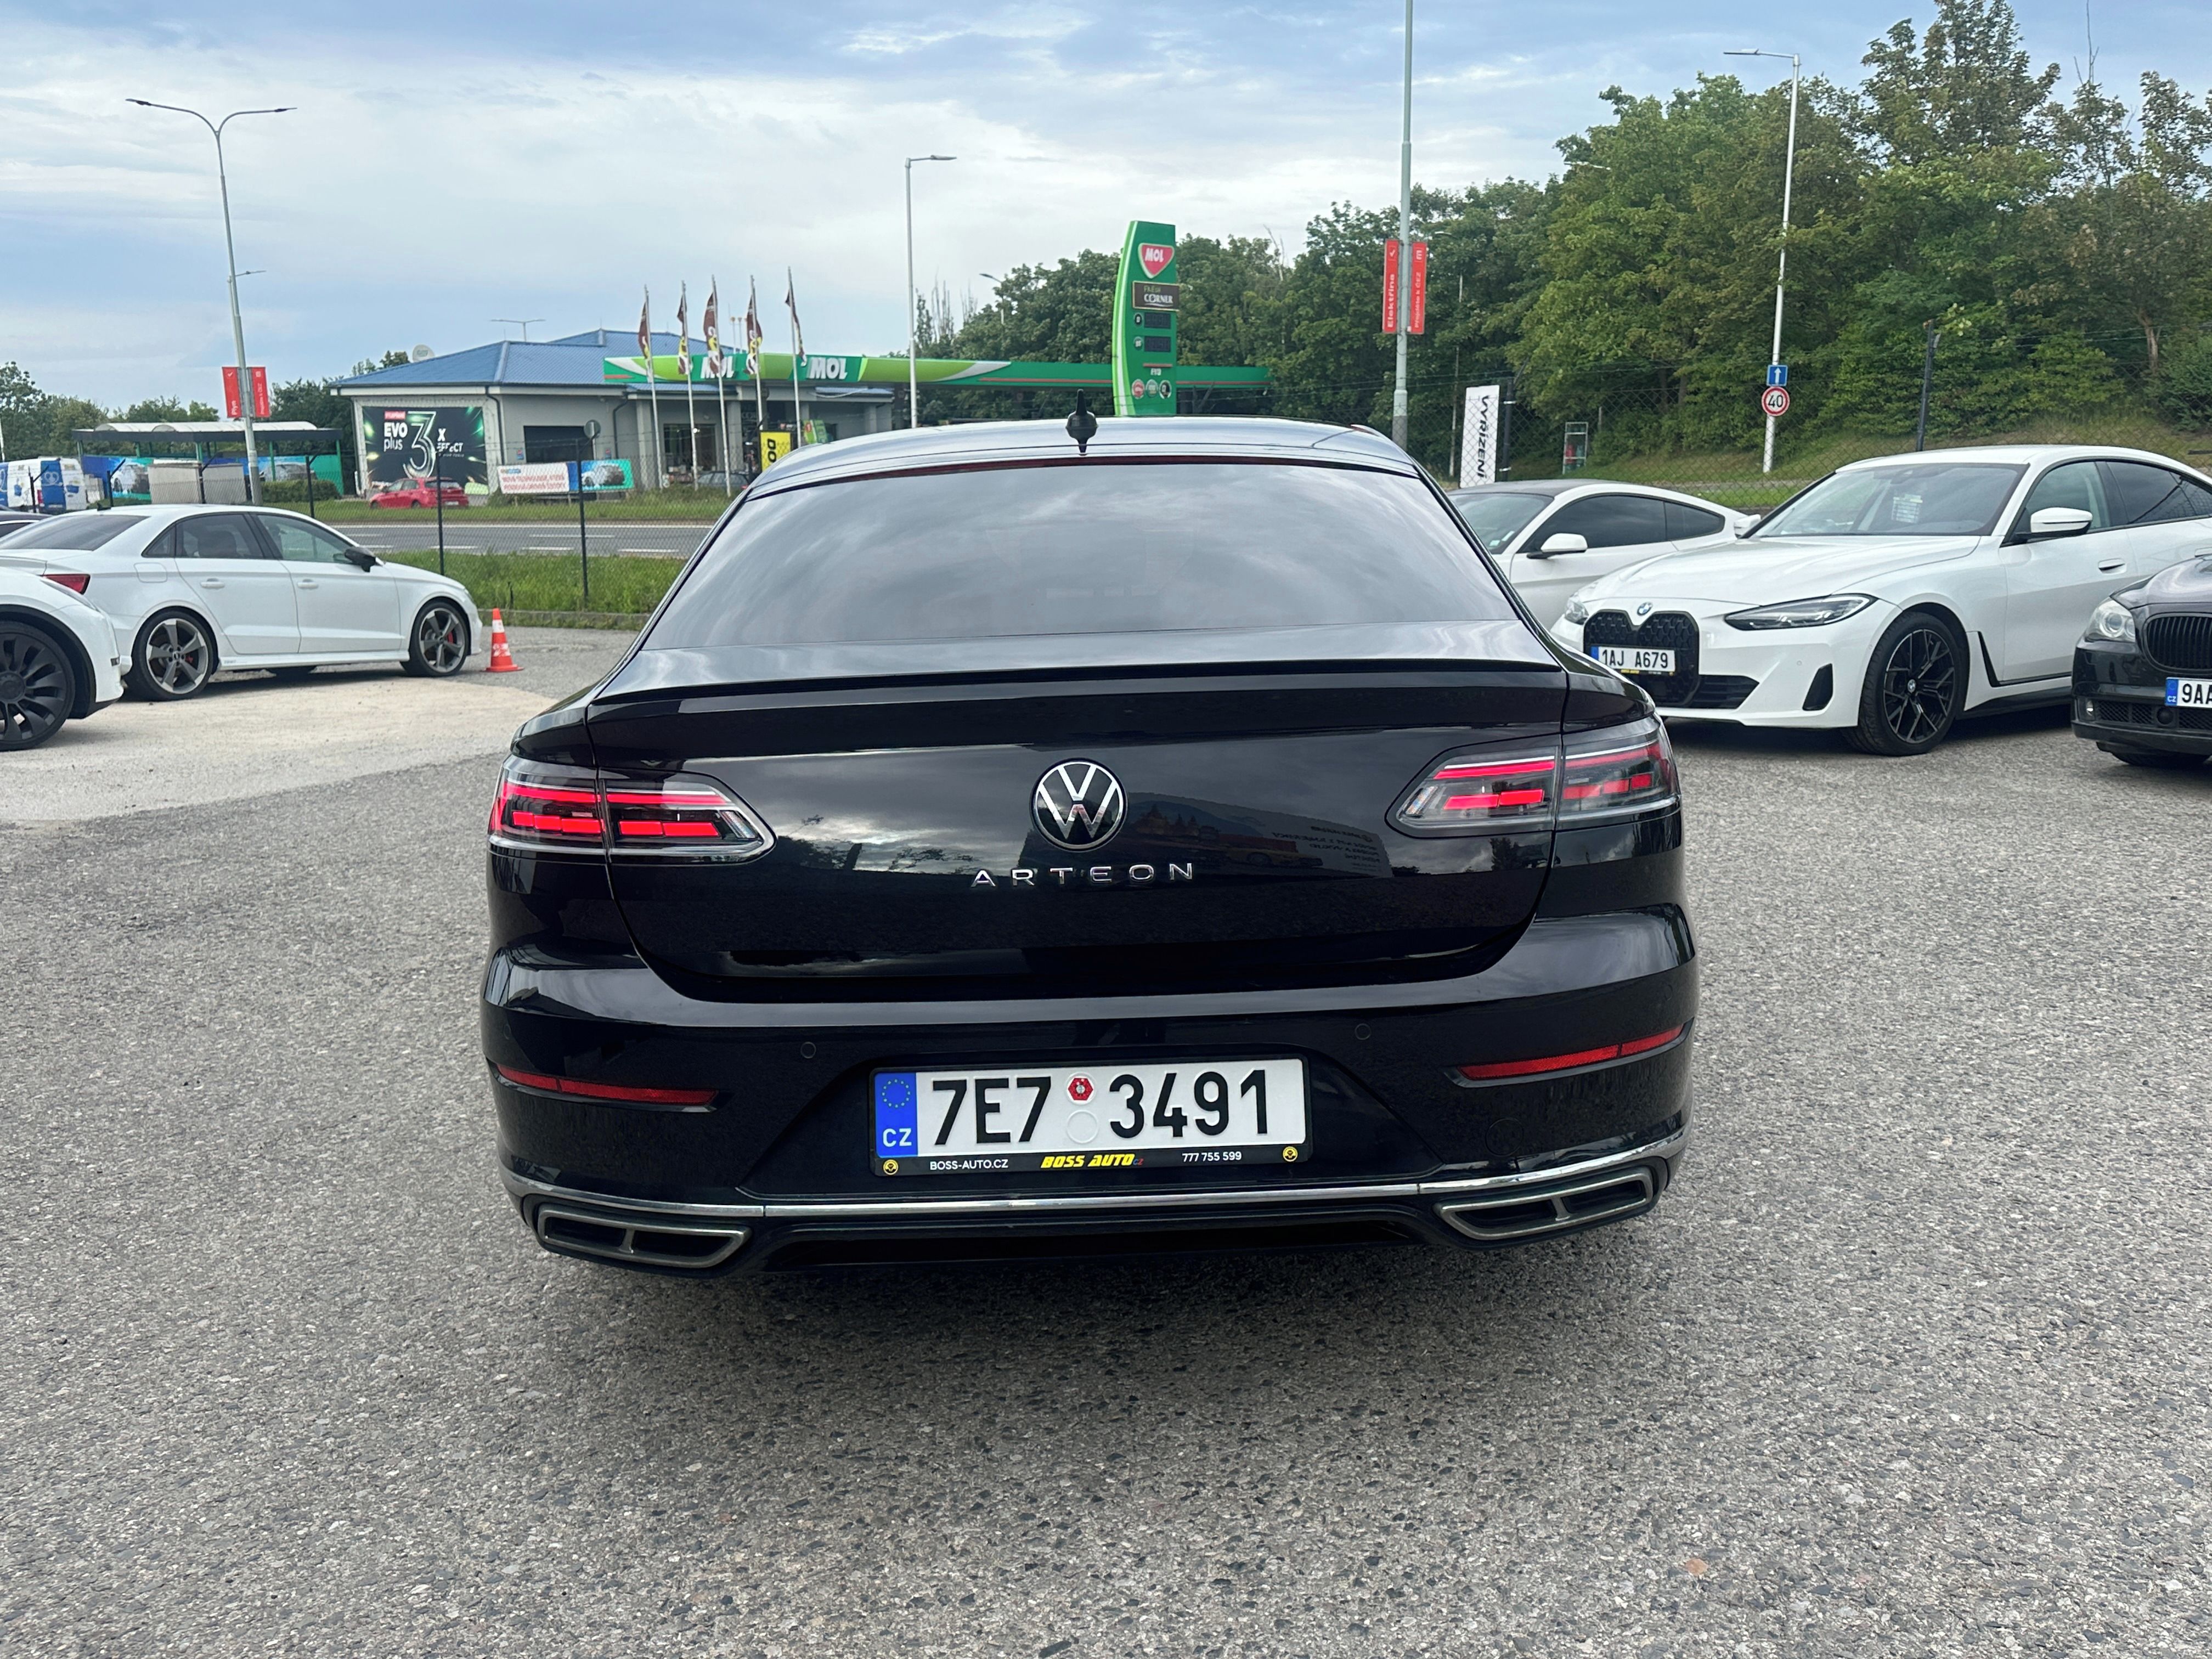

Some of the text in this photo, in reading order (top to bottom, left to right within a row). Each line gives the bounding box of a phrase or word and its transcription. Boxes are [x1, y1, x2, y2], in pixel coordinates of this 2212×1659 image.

[1145, 247, 1164, 262] MOL
[1143, 294, 1173, 303] CORNER
[1387, 274, 1395, 328] Elektřina
[808, 357, 848, 380] MOL
[1768, 394, 1784, 408] 40
[384, 422, 408, 438] EVO
[384, 438, 403, 452] plus
[403, 411, 446, 479] 3 X
[1602, 649, 1668, 669] 1AJ A679
[2182, 683, 2212, 704] 9AA
[970, 862, 1194, 888] ARTEON
[932, 1069, 1268, 1146] 7E7 3491
[882, 1127, 912, 1147] CZ
[929, 1159, 1009, 1171] BOSS-AUTO.CZ
[1040, 1155, 1086, 1169] BOSS
[1087, 1154, 1135, 1167] AUTO
[1182, 1151, 1243, 1163] 777 755 599
